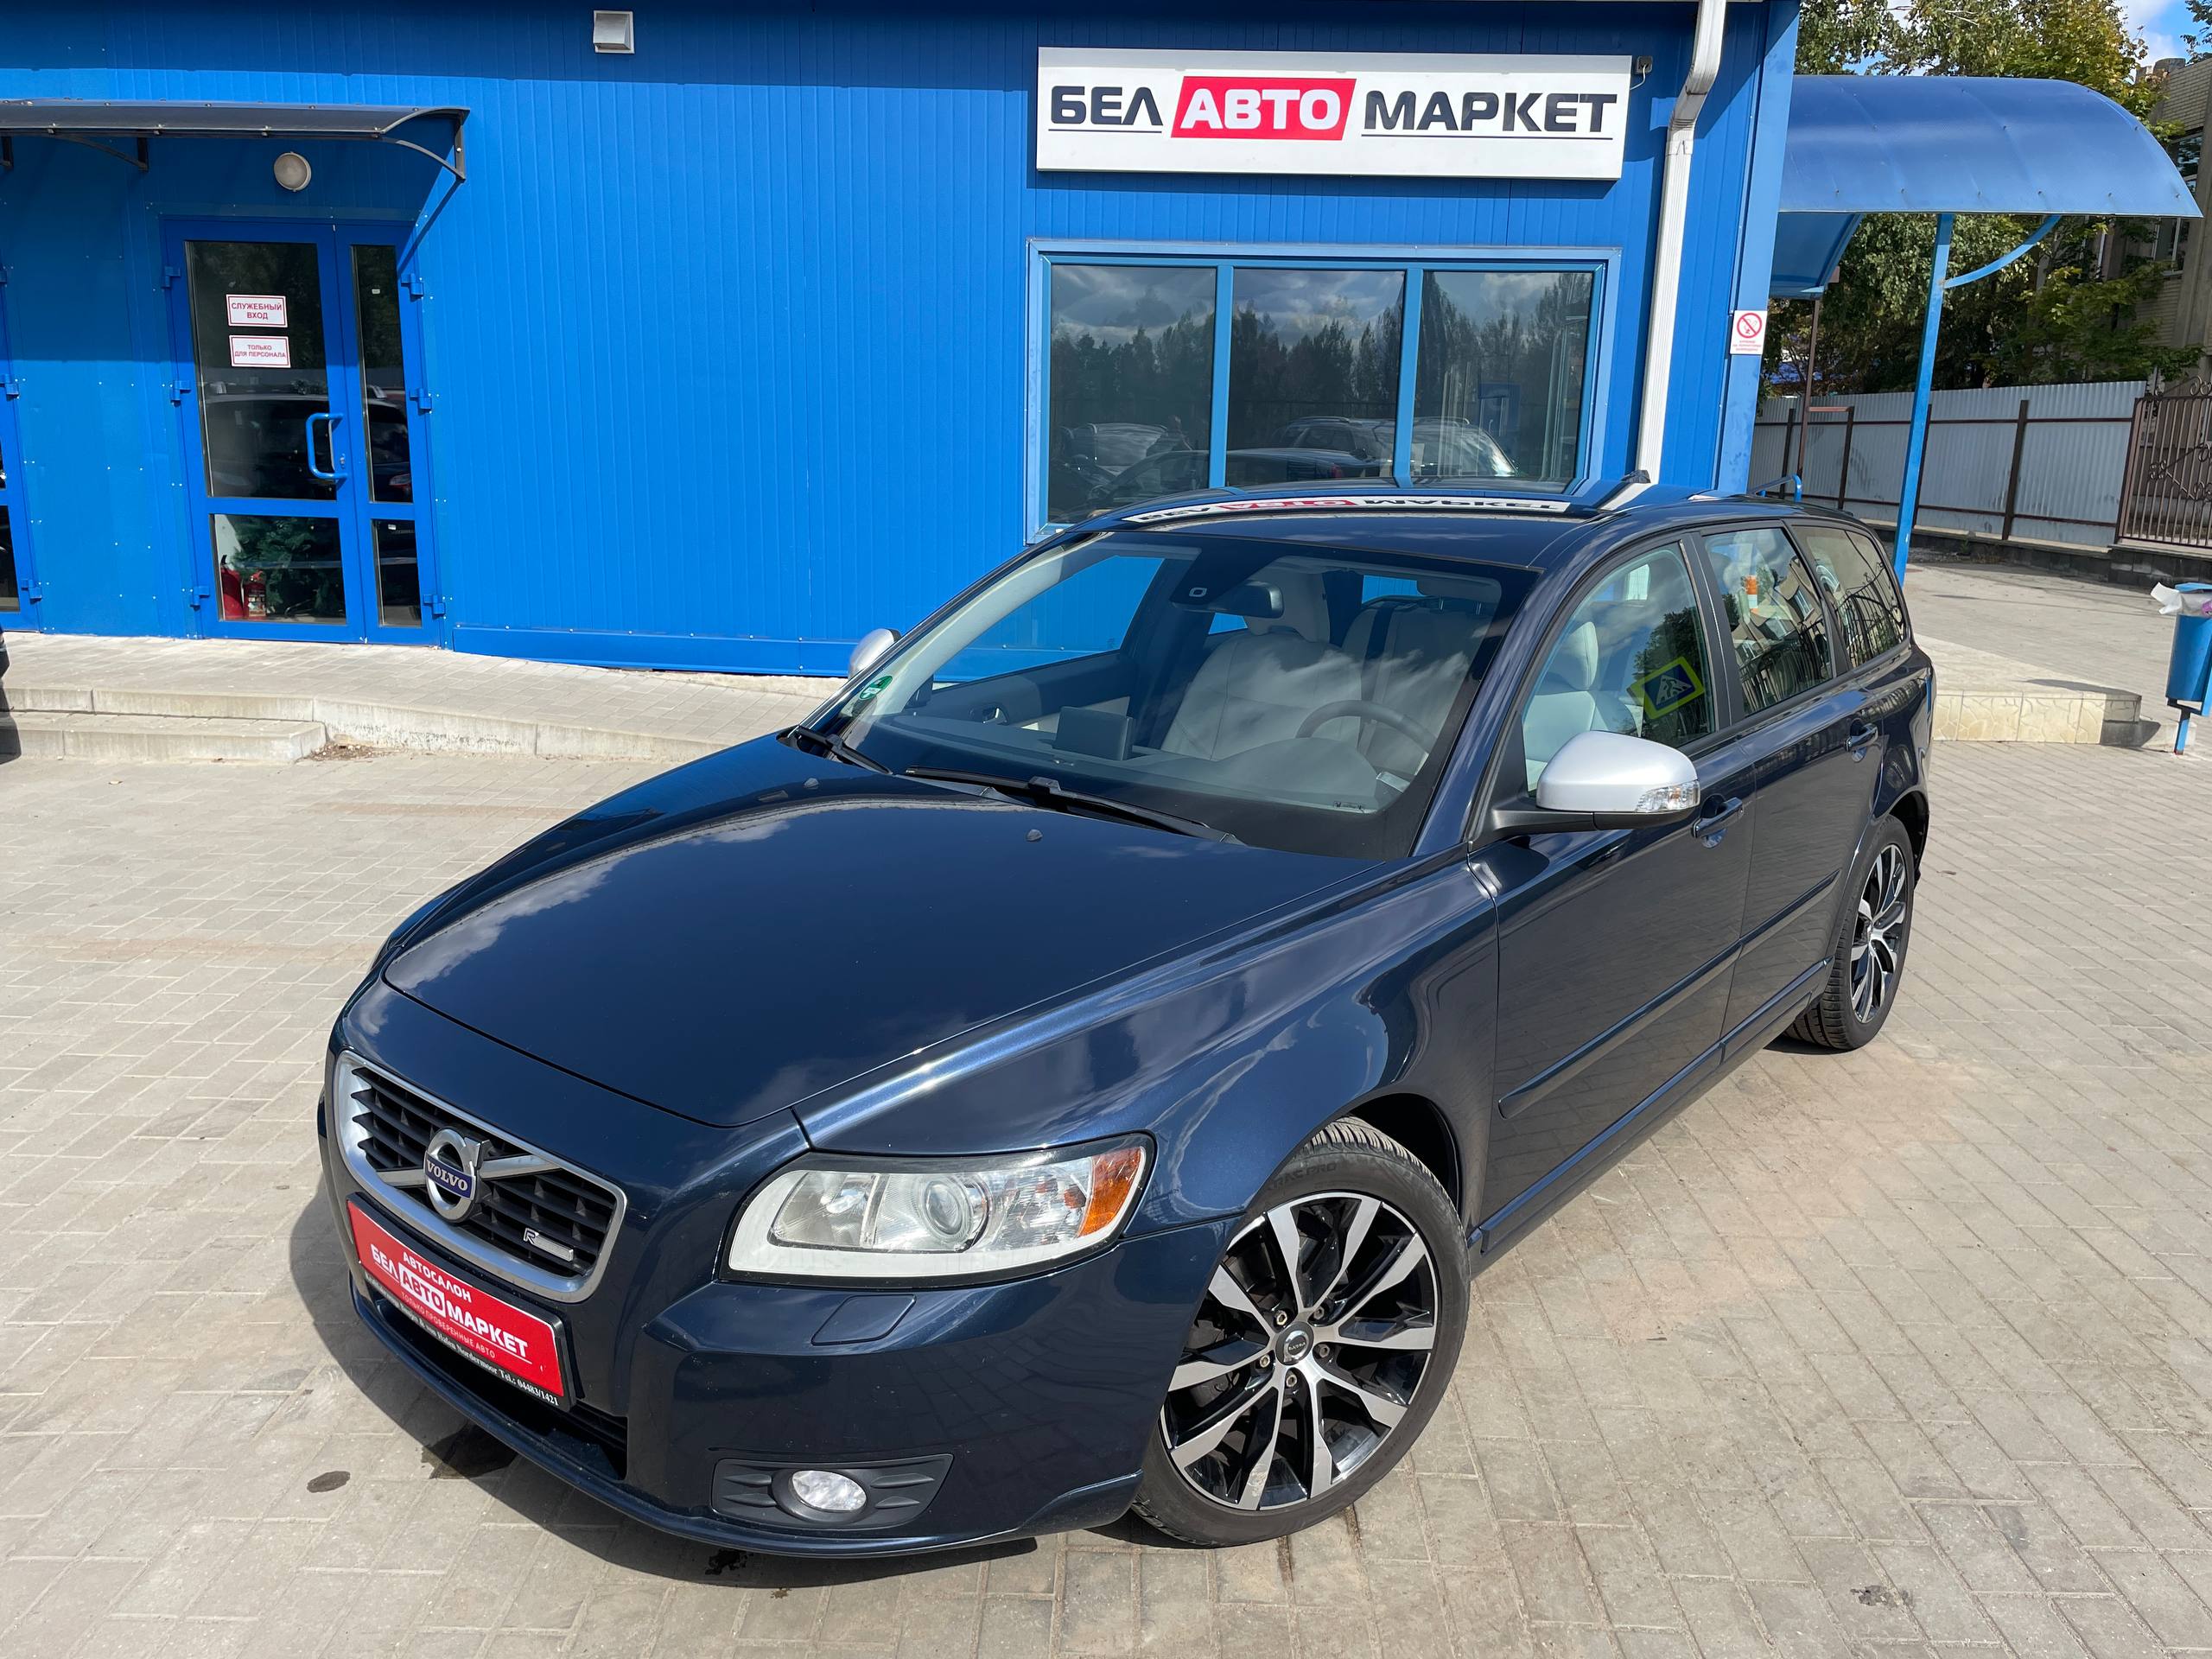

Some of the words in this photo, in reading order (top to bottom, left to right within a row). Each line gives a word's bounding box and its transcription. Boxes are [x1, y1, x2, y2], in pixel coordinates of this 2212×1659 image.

[1051, 86, 1164, 126] БЕЛ
[1180, 88, 1341, 130] АВТО
[1364, 90, 1618, 132] МАРКЕТ
[426, 1159, 468, 1192] VOLVO
[370, 1243, 399, 1280] БЕЛ
[401, 1269, 444, 1312] АВТО
[446, 1300, 529, 1357] МАРКЕТ
[403, 1251, 472, 1303] АВТОСАЛОН
[475, 1342, 496, 1358] АВТО
